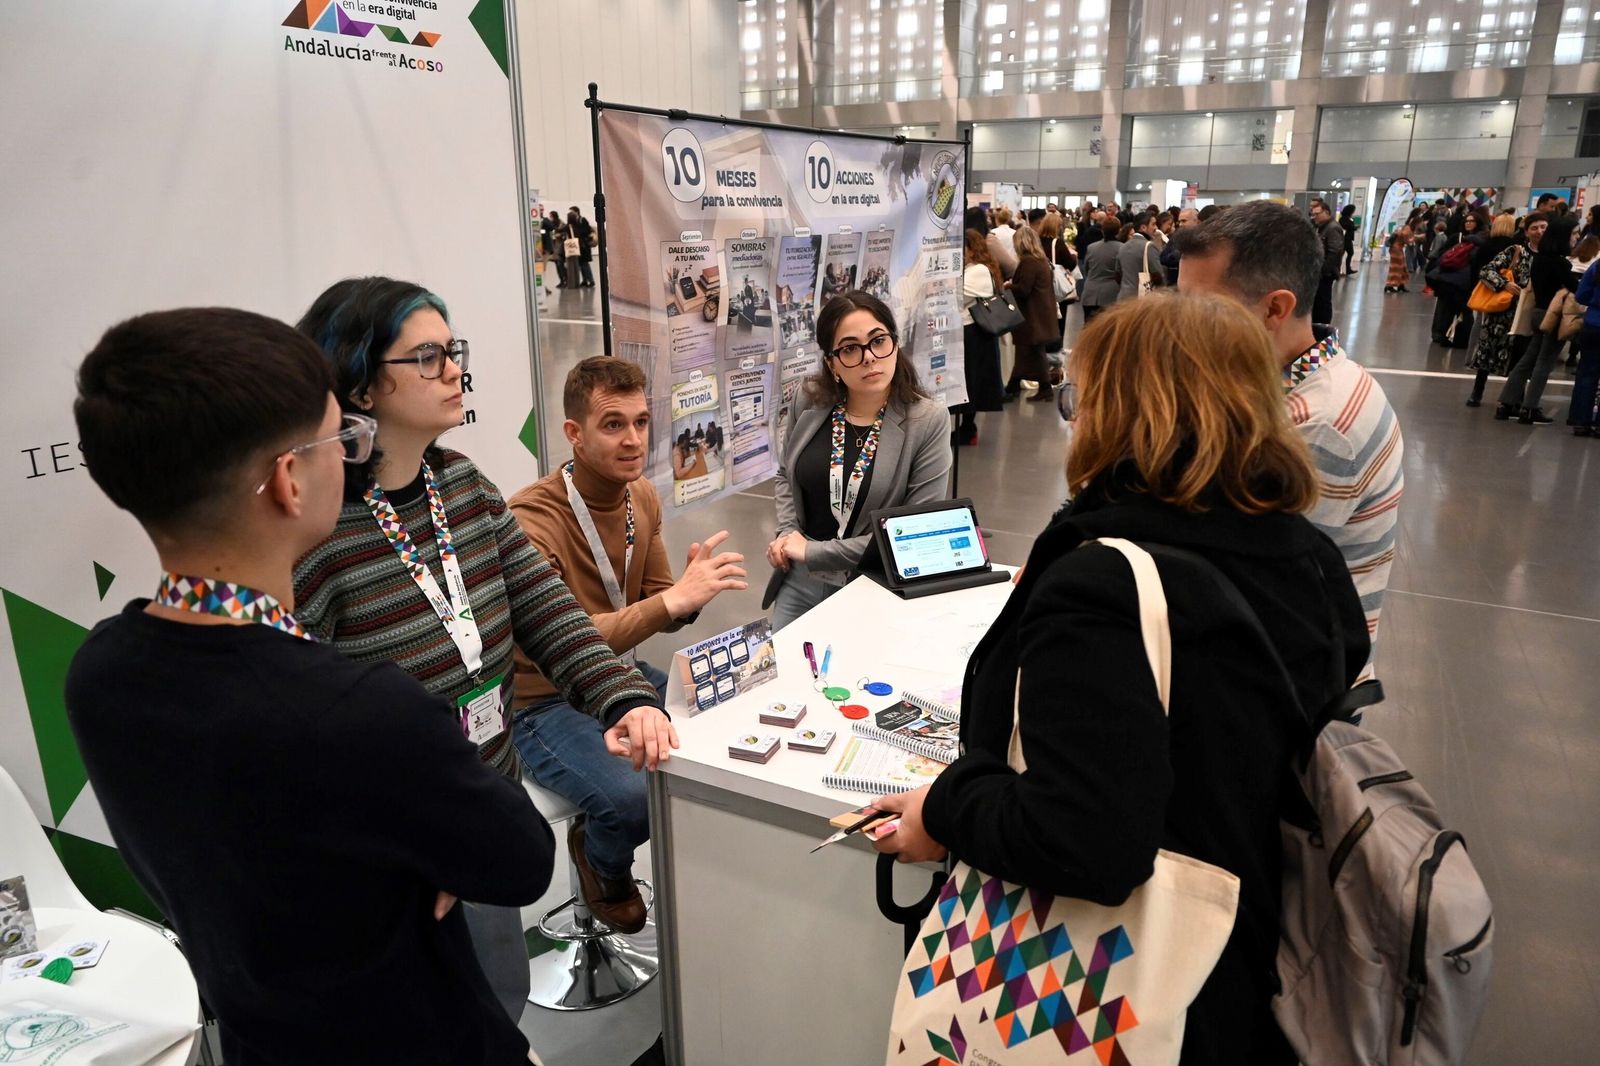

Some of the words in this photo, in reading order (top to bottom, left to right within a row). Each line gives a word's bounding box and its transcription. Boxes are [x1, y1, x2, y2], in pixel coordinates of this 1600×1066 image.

[342, 1, 355, 10] en
[357, 0, 366, 12] la
[368, 5, 384, 15] era
[386, 6, 416, 21] digital
[284, 35, 372, 61] Andalucía
[371, 49, 397, 59] frente
[399, 54, 443, 72] Acoso
[665, 146, 701, 186] 10
[808, 156, 831, 190] 10
[716, 170, 757, 188] MESES
[835, 170, 874, 185] ACCIONES
[701, 195, 725, 211] para
[725, 194, 735, 207] la
[736, 194, 783, 207] convivencia
[831, 194, 840, 204] en
[840, 193, 847, 204] la
[848, 195, 859, 204] era
[860, 194, 880, 207] digital
[668, 246, 684, 254] DALE
[685, 245, 710, 254] DESCANSO
[731, 242, 767, 253] SOMBRAS
[679, 391, 712, 409] TUTORÍA
[687, 649, 694, 657] 10
[972, 1048, 1002, 1066] Congr
